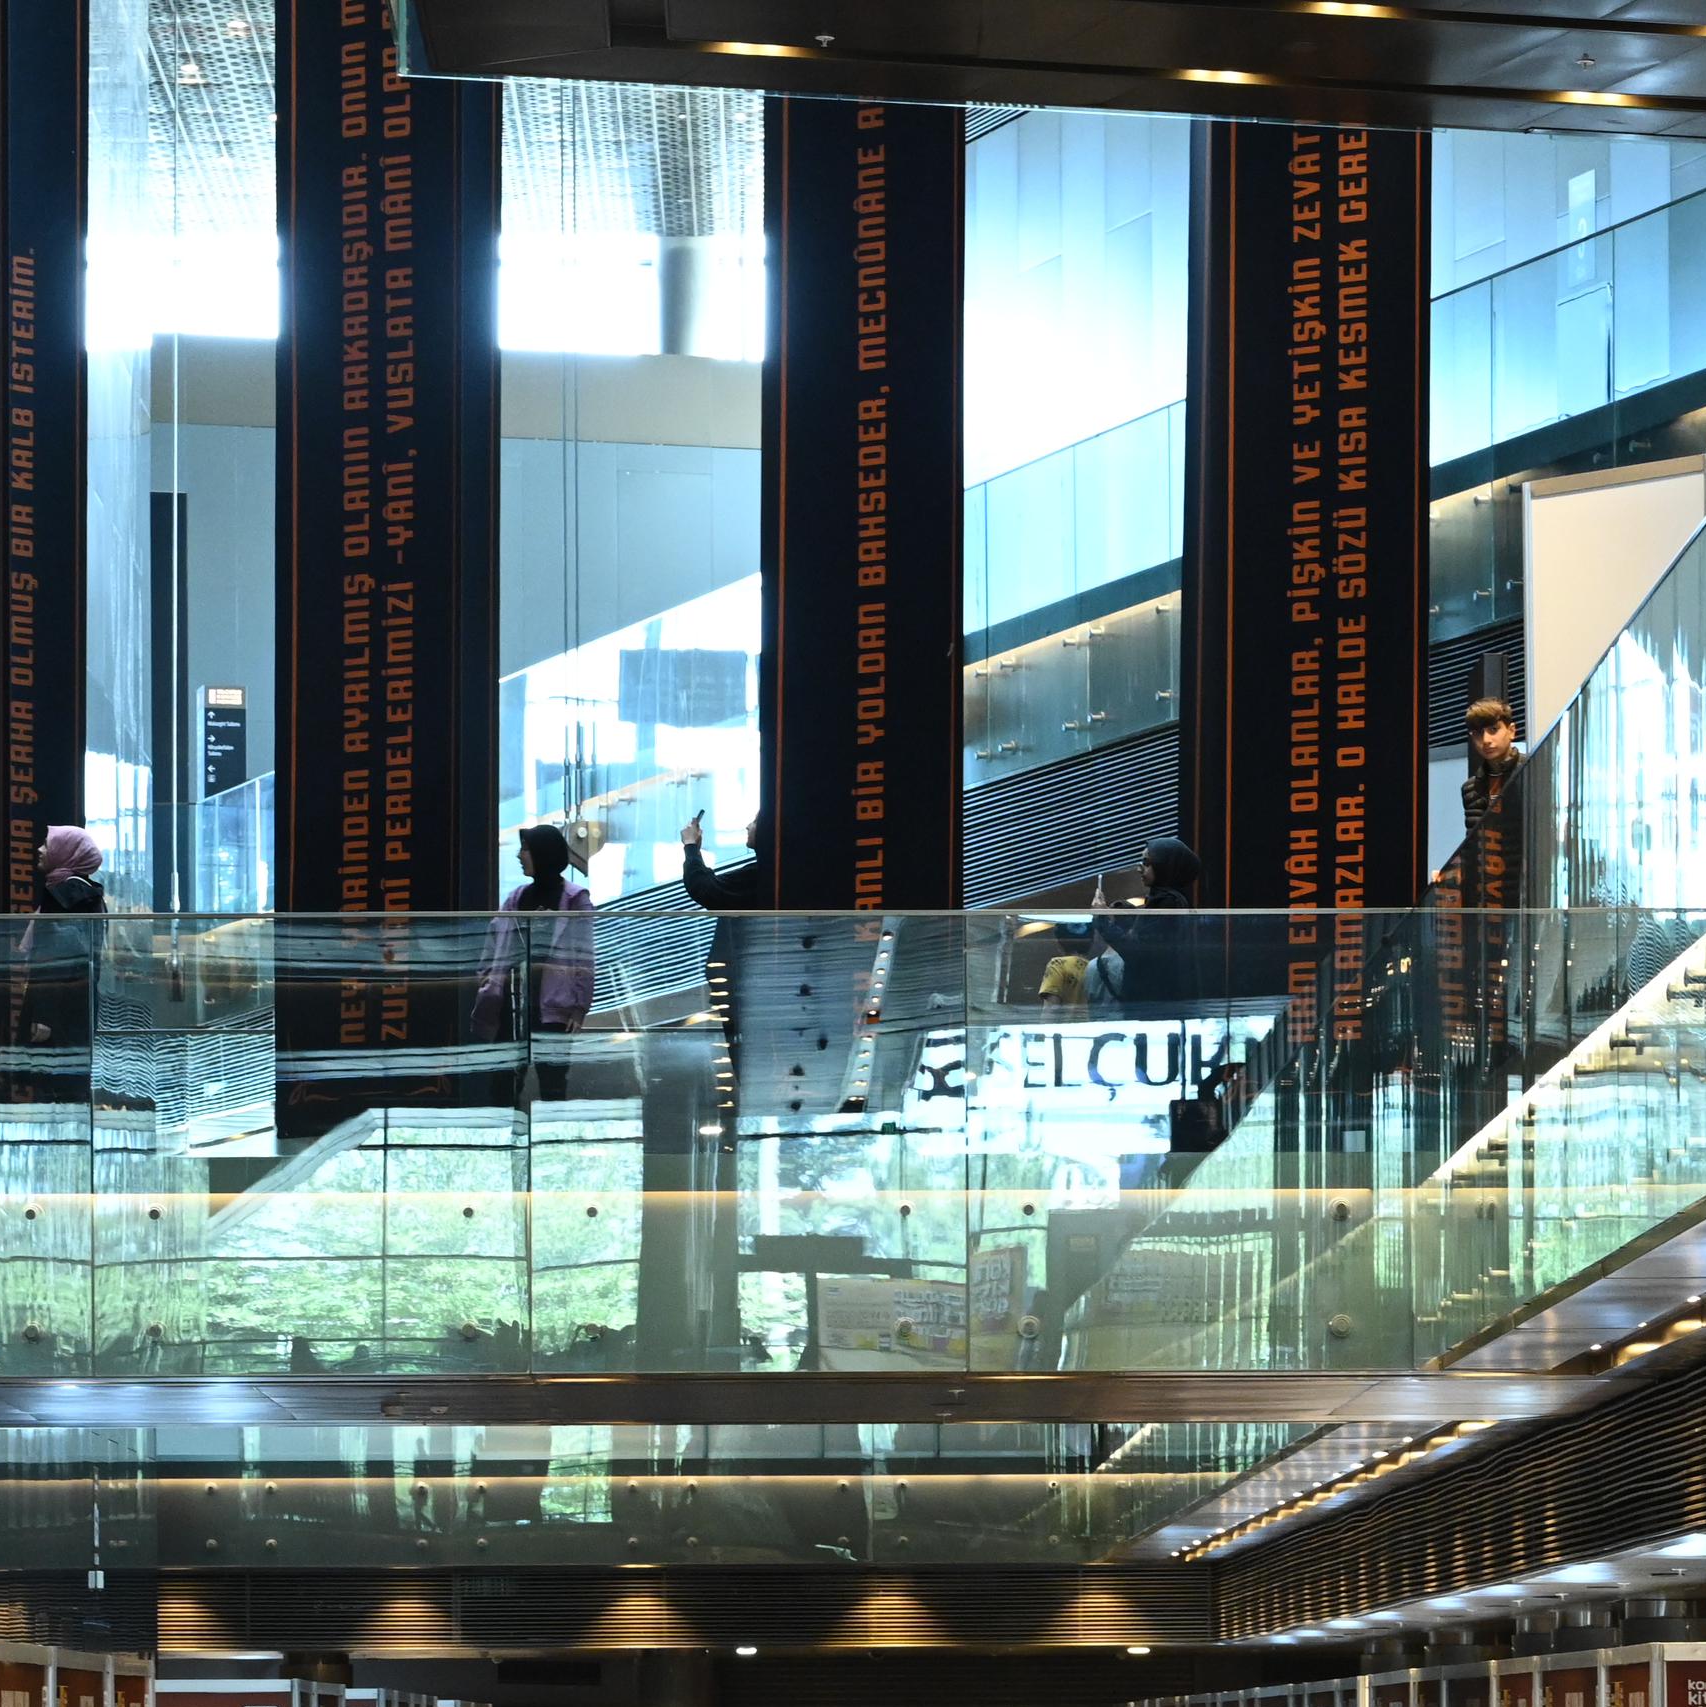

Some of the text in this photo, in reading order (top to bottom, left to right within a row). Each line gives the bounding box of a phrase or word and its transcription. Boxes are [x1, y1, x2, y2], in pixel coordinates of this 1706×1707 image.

[341, 39, 369, 138] ONUN
[381, 153, 413, 251] MÂNÎ
[853, 144, 888, 373] MECNÛNÂNE
[10, 247, 35, 394] İSTERİM.
[343, 152, 374, 411] ARKADAŞIDIR.
[1288, 255, 1326, 426] YETİŞKİN
[1338, 237, 1370, 390] KESMEK
[386, 266, 416, 433] VUSLATA
[12, 406, 36, 491] KALB
[344, 425, 372, 558] OLANIN
[380, 447, 417, 565] -YÂNÎ,
[857, 384, 892, 587] BAHSEDER,
[1292, 439, 1323, 484] VE
[1338, 404, 1369, 492] KISA
[1288, 498, 1326, 622] PİŞKİN
[1333, 505, 1369, 599] SÖZÜ
[10, 571, 39, 687] OLMUŞ
[343, 571, 377, 753] AYRILMIŞ
[857, 601, 887, 745] YOLDAN
[1337, 613, 1368, 730] HALDE
[9, 698, 39, 803] ŞERHA
[384, 580, 416, 863] PERDELERİMİZİ
[1289, 636, 1324, 813] OLANLAR,
[1336, 744, 1367, 768] O
[853, 759, 886, 821] BİR
[1284, 826, 1319, 944] ERVÂH
